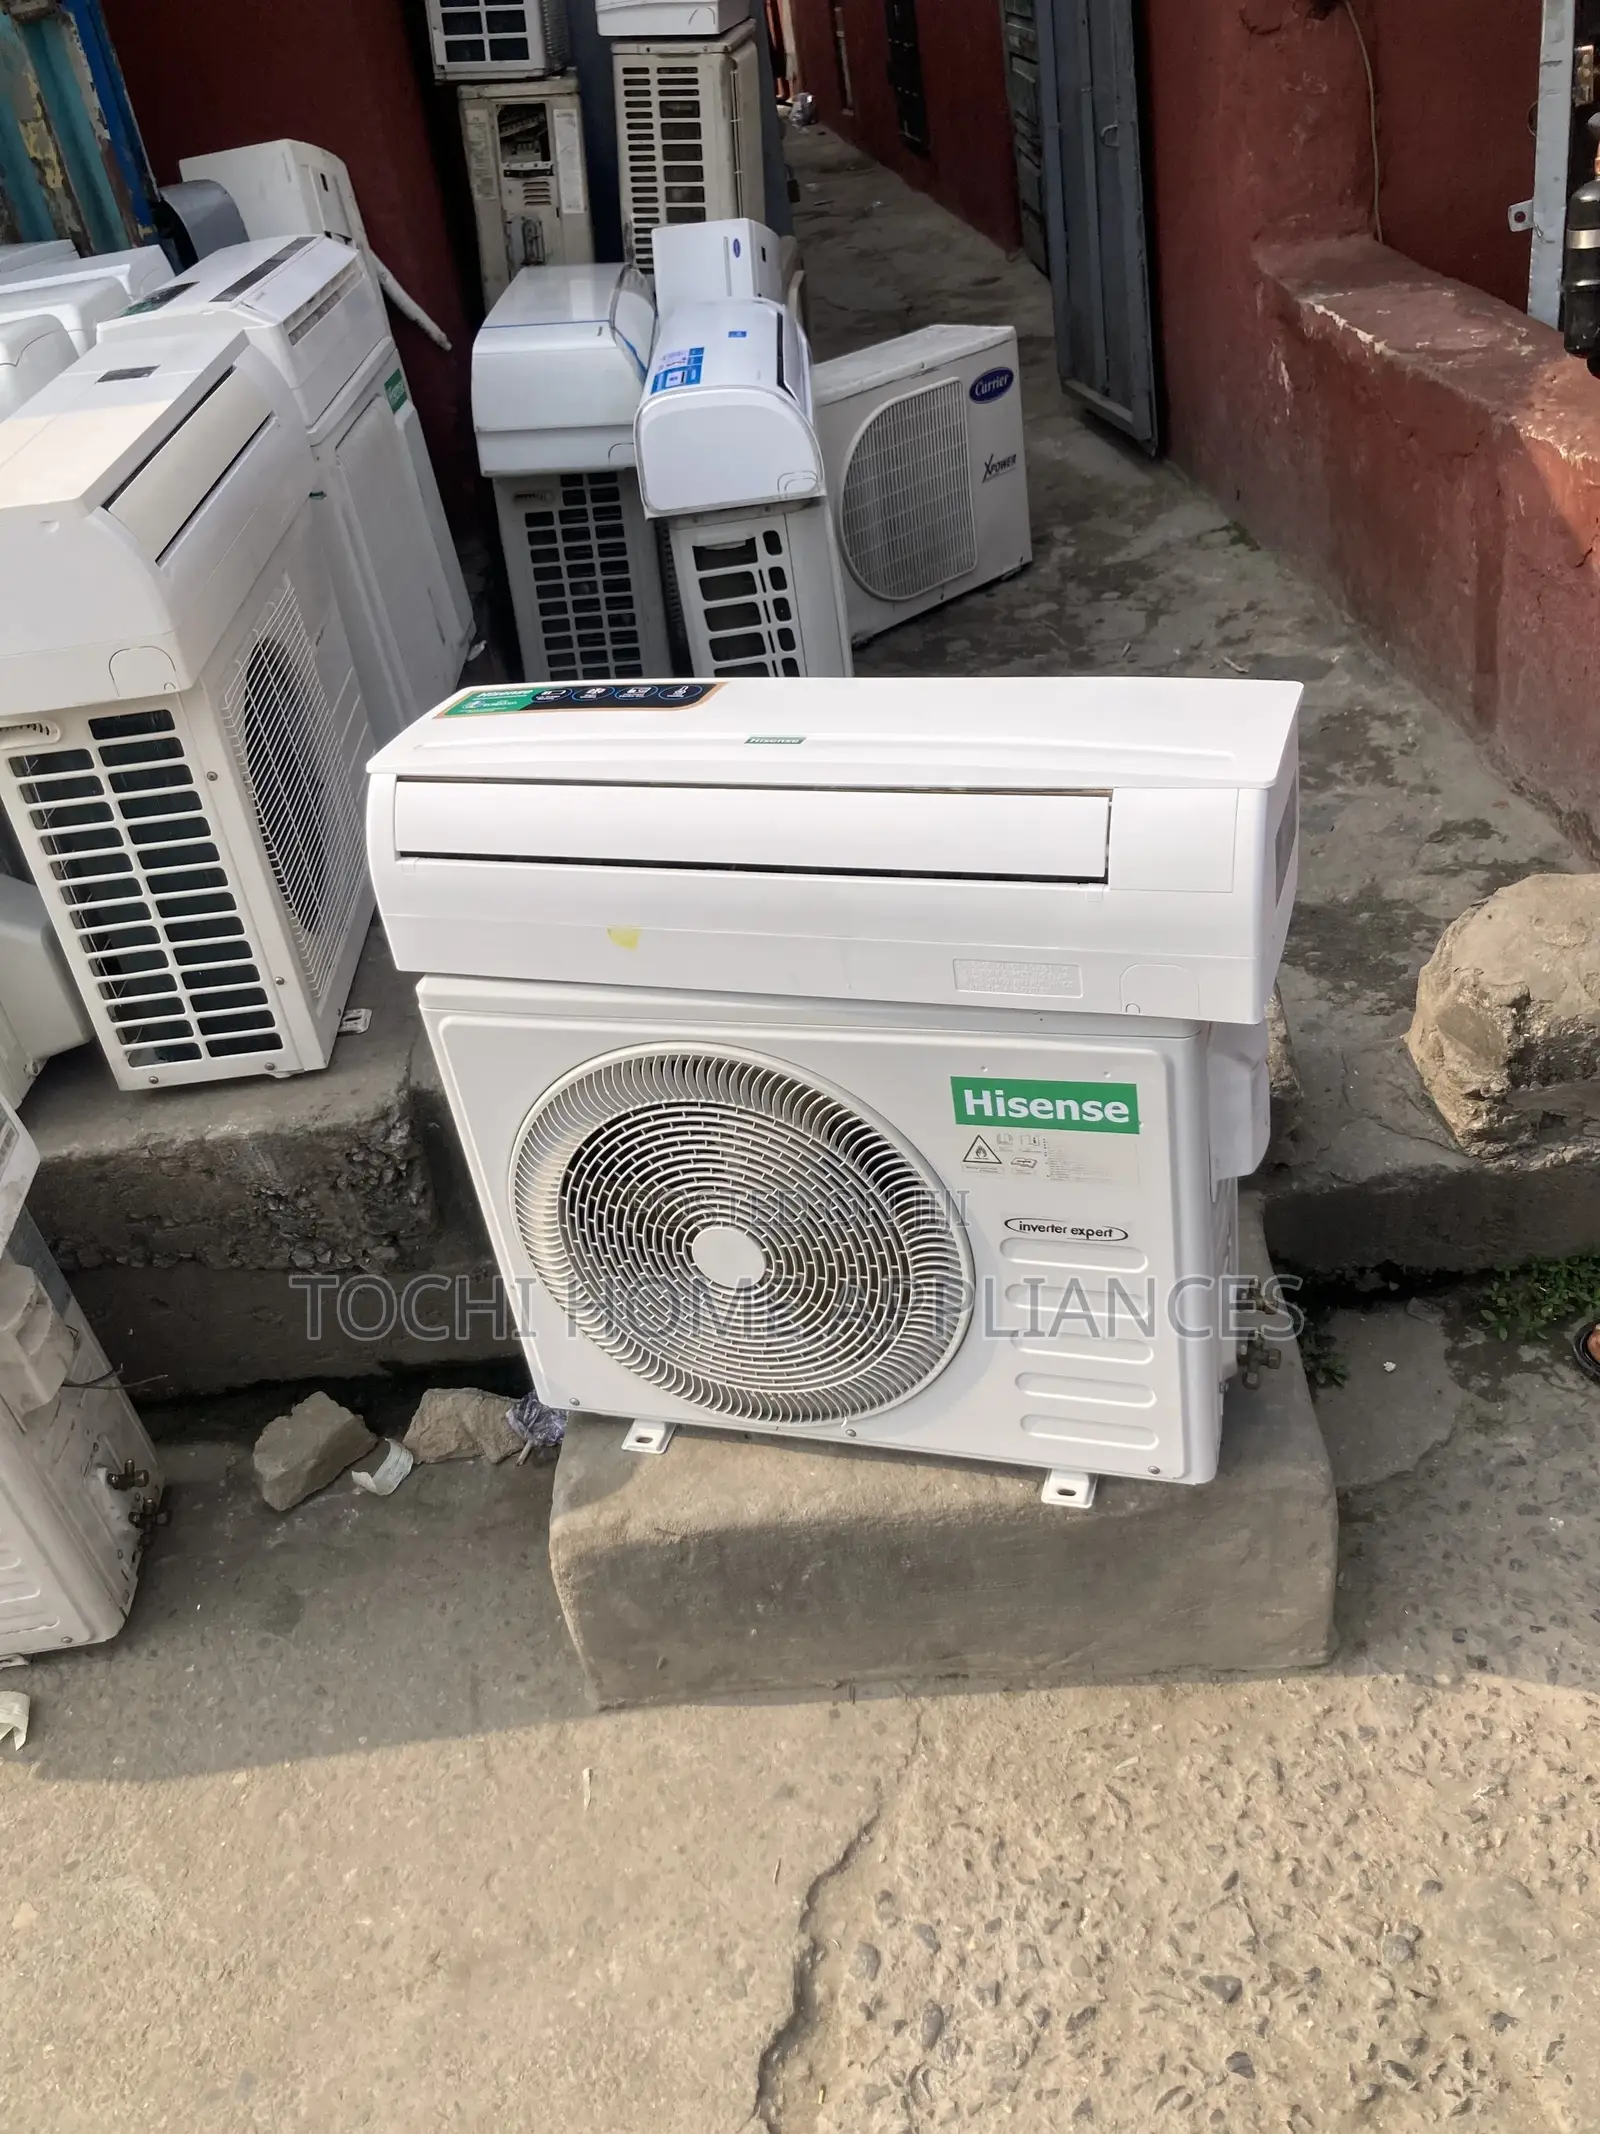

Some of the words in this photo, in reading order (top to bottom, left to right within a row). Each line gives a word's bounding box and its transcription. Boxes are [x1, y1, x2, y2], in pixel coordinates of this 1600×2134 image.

[975, 374, 1008, 396] Carrier
[964, 1089, 1129, 1123] Hisense
[1019, 1220, 1067, 1233] inverter
[1070, 1227, 1113, 1240] expert
